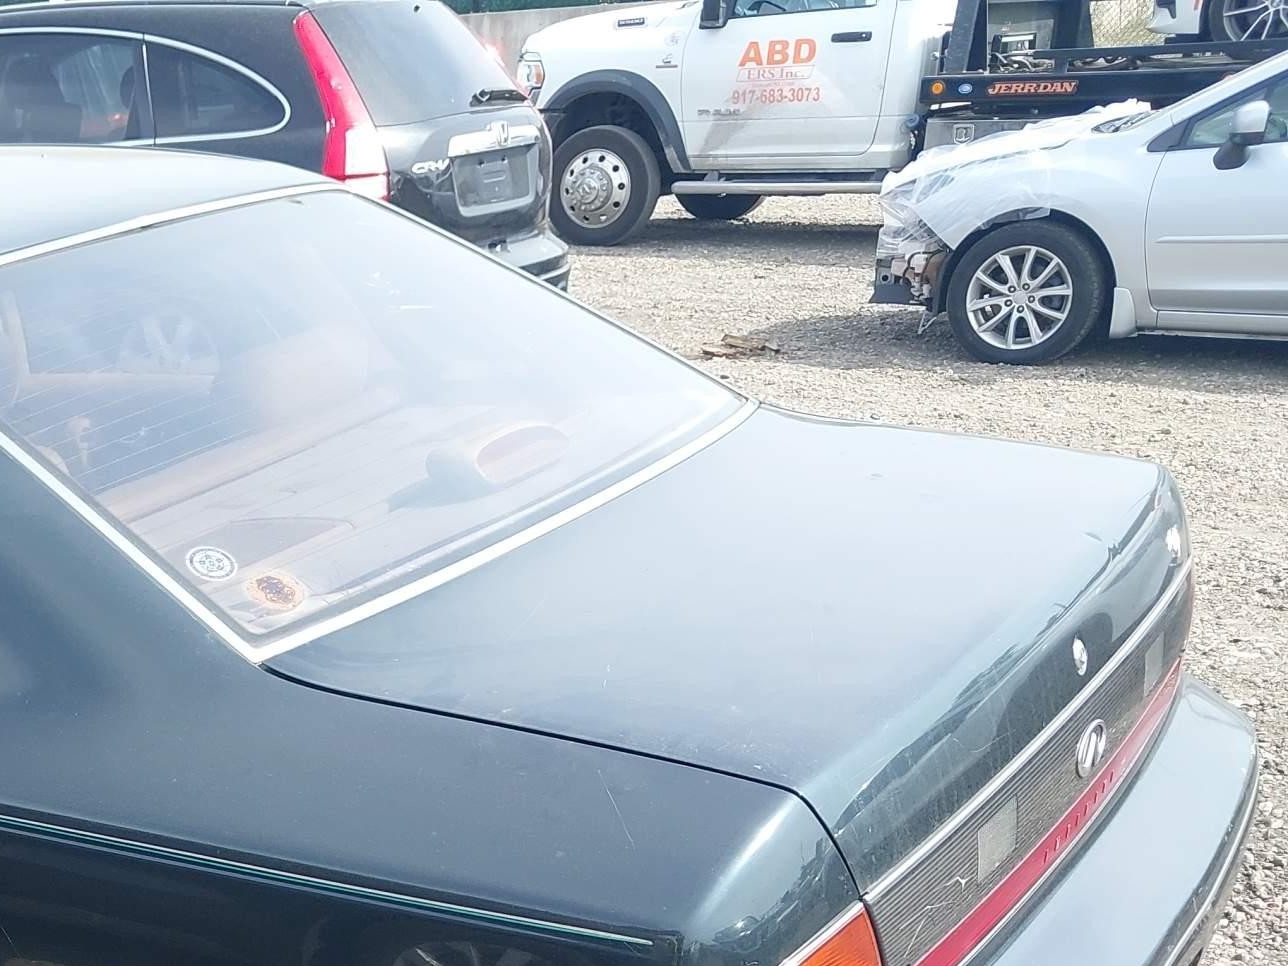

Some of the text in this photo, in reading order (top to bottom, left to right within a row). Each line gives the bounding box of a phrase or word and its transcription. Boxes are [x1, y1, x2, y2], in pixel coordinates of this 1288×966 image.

[738, 38, 817, 67] ABD
[779, 67, 805, 79] Inc.
[731, 86, 821, 105] 917-683-3073
